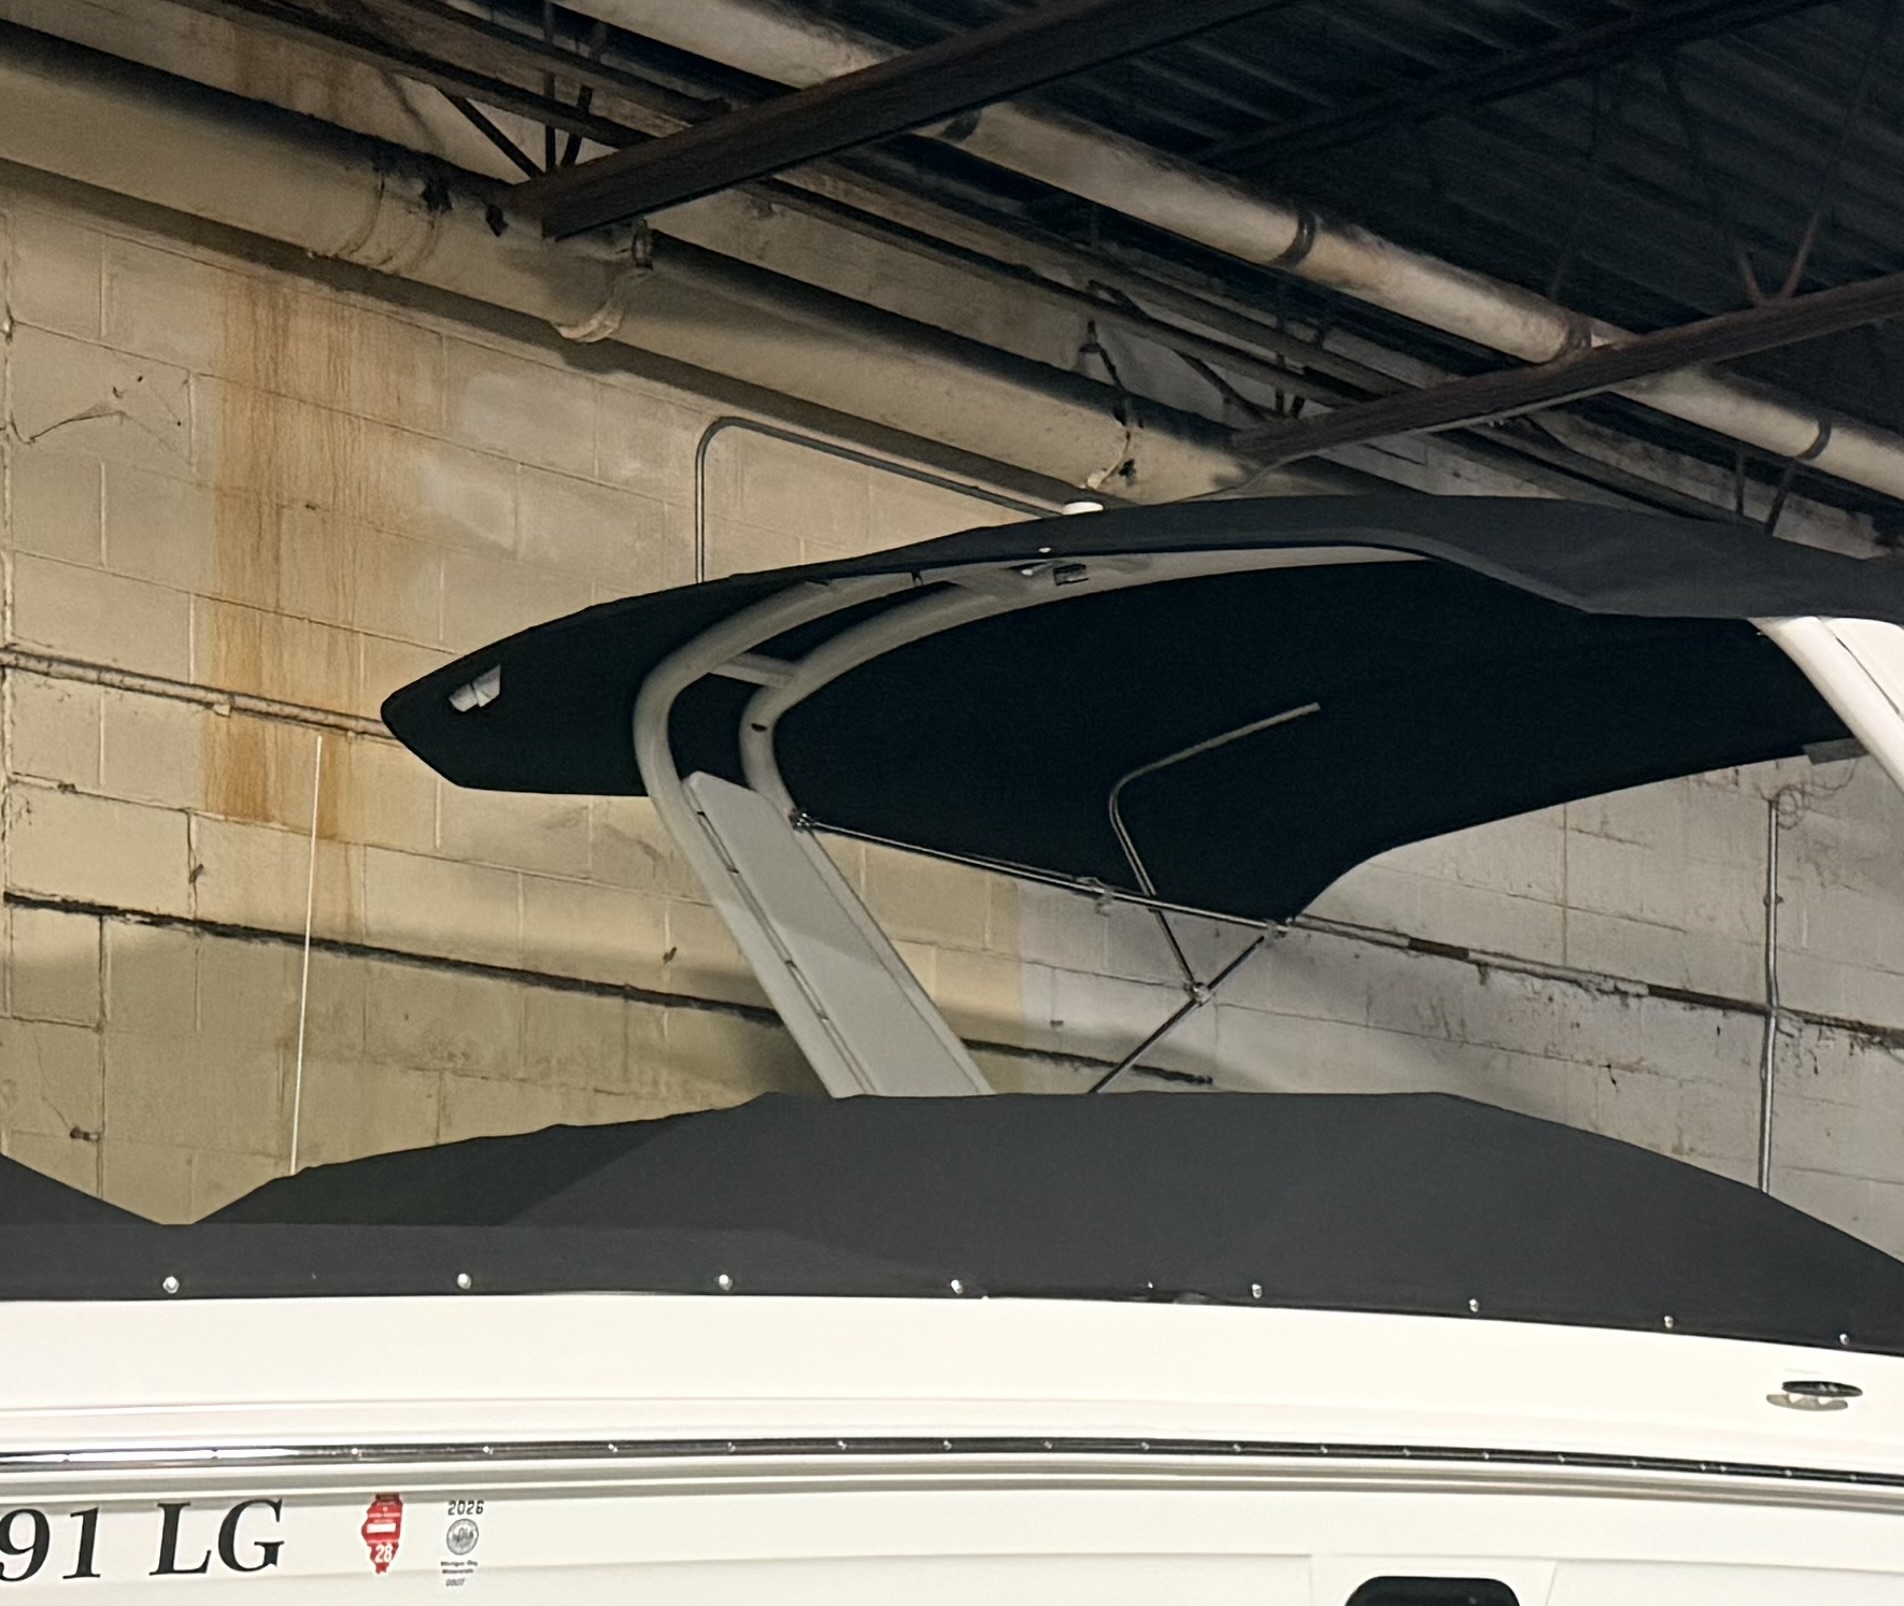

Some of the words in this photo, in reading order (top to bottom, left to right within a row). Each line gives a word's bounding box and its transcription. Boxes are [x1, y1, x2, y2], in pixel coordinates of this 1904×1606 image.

[447, 1500, 484, 1516] 2026
[149, 1498, 285, 1577] LG
[375, 1543, 394, 1563] 28
